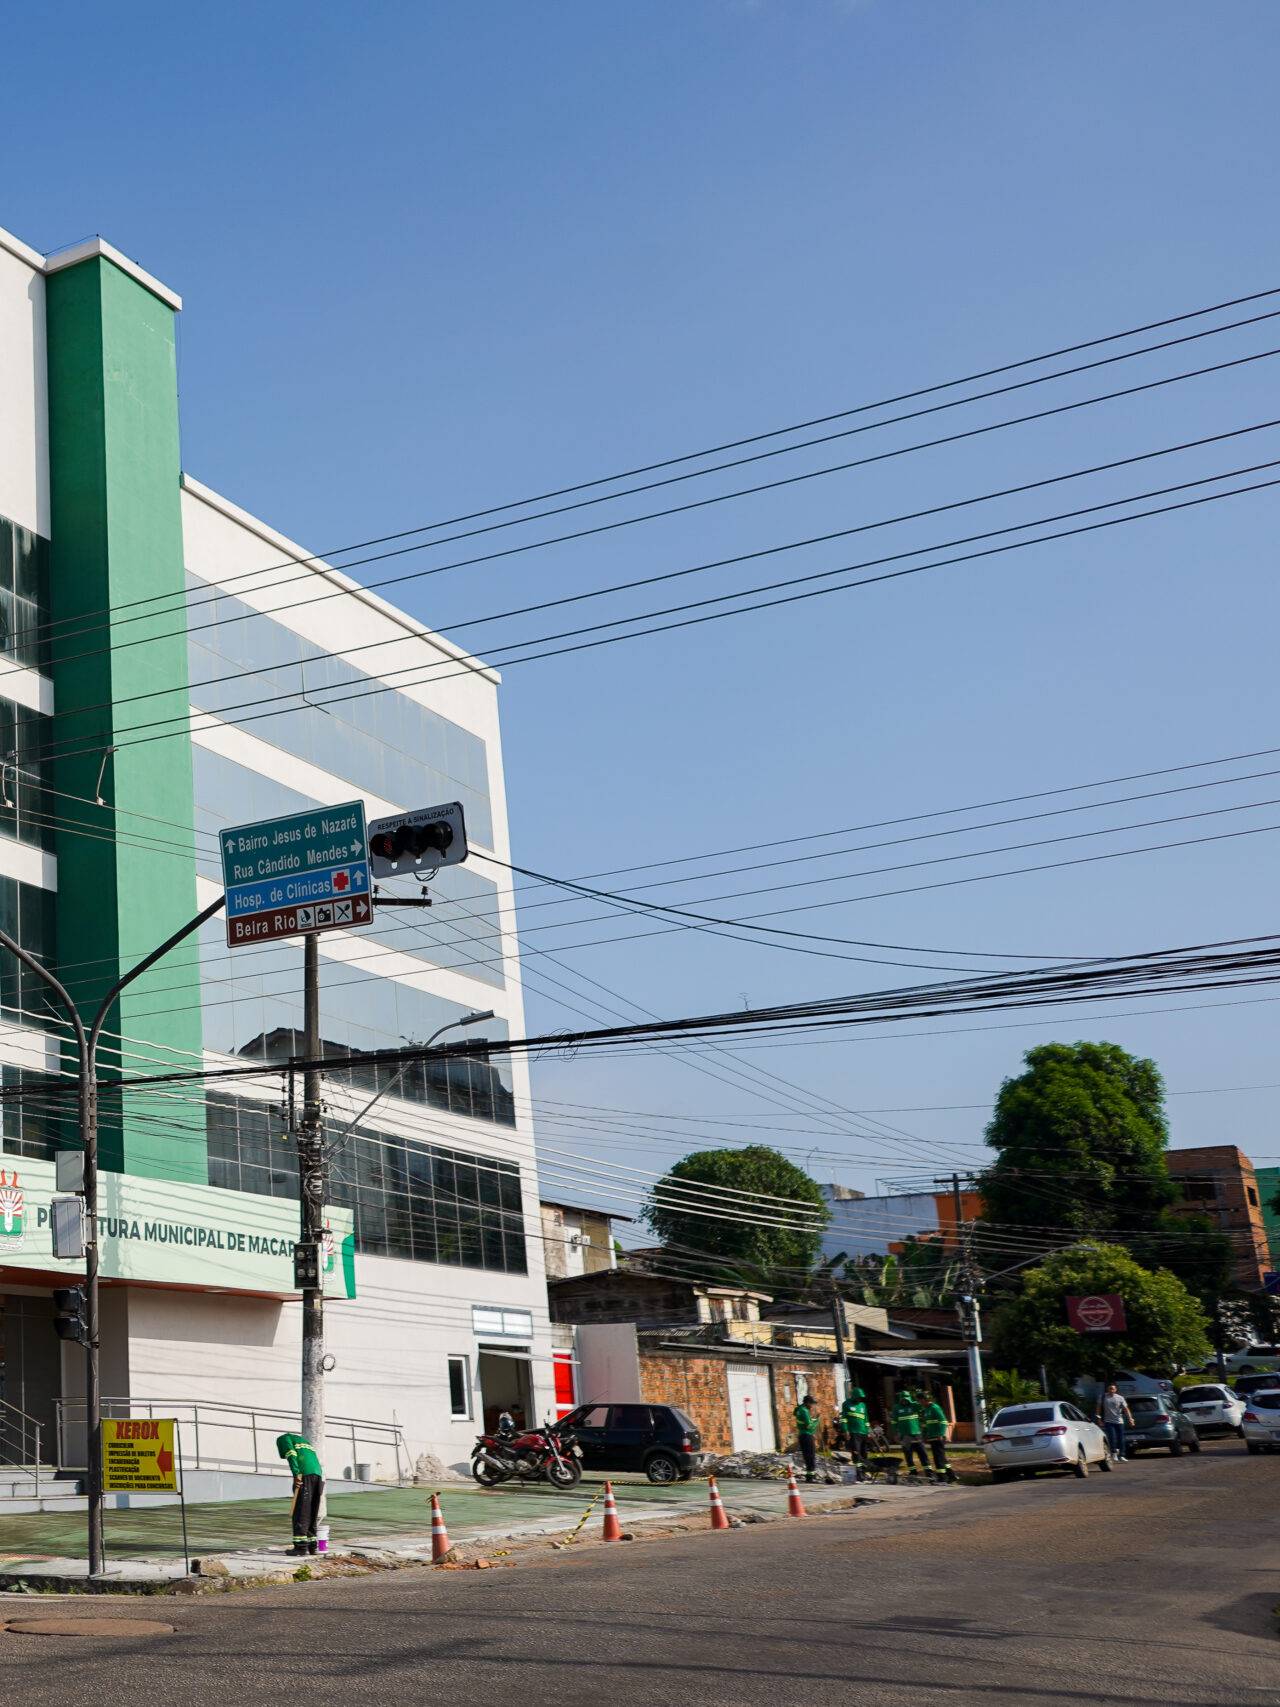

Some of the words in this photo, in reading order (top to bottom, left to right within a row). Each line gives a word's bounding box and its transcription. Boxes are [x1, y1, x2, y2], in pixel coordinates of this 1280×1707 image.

[377, 818, 406, 830] RESPEITE
[413, 808, 454, 823] SINALIZAÇÃO
[238, 835, 268, 852] Bairro
[272, 828, 302, 846] Jesus
[304, 823, 317, 839] de
[321, 813, 357, 835] Nazaré
[233, 864, 254, 880] Rua
[257, 853, 300, 876] Cândido
[306, 844, 348, 865] Mendes
[234, 894, 265, 910] Hosp.
[270, 887, 283, 903] de
[235, 920, 269, 938] Beira
[274, 915, 296, 932] Rio
[144, 1222, 224, 1249] MUNICIPAL
[227, 1232, 246, 1252] DE
[116, 1421, 160, 1440] XEROX
